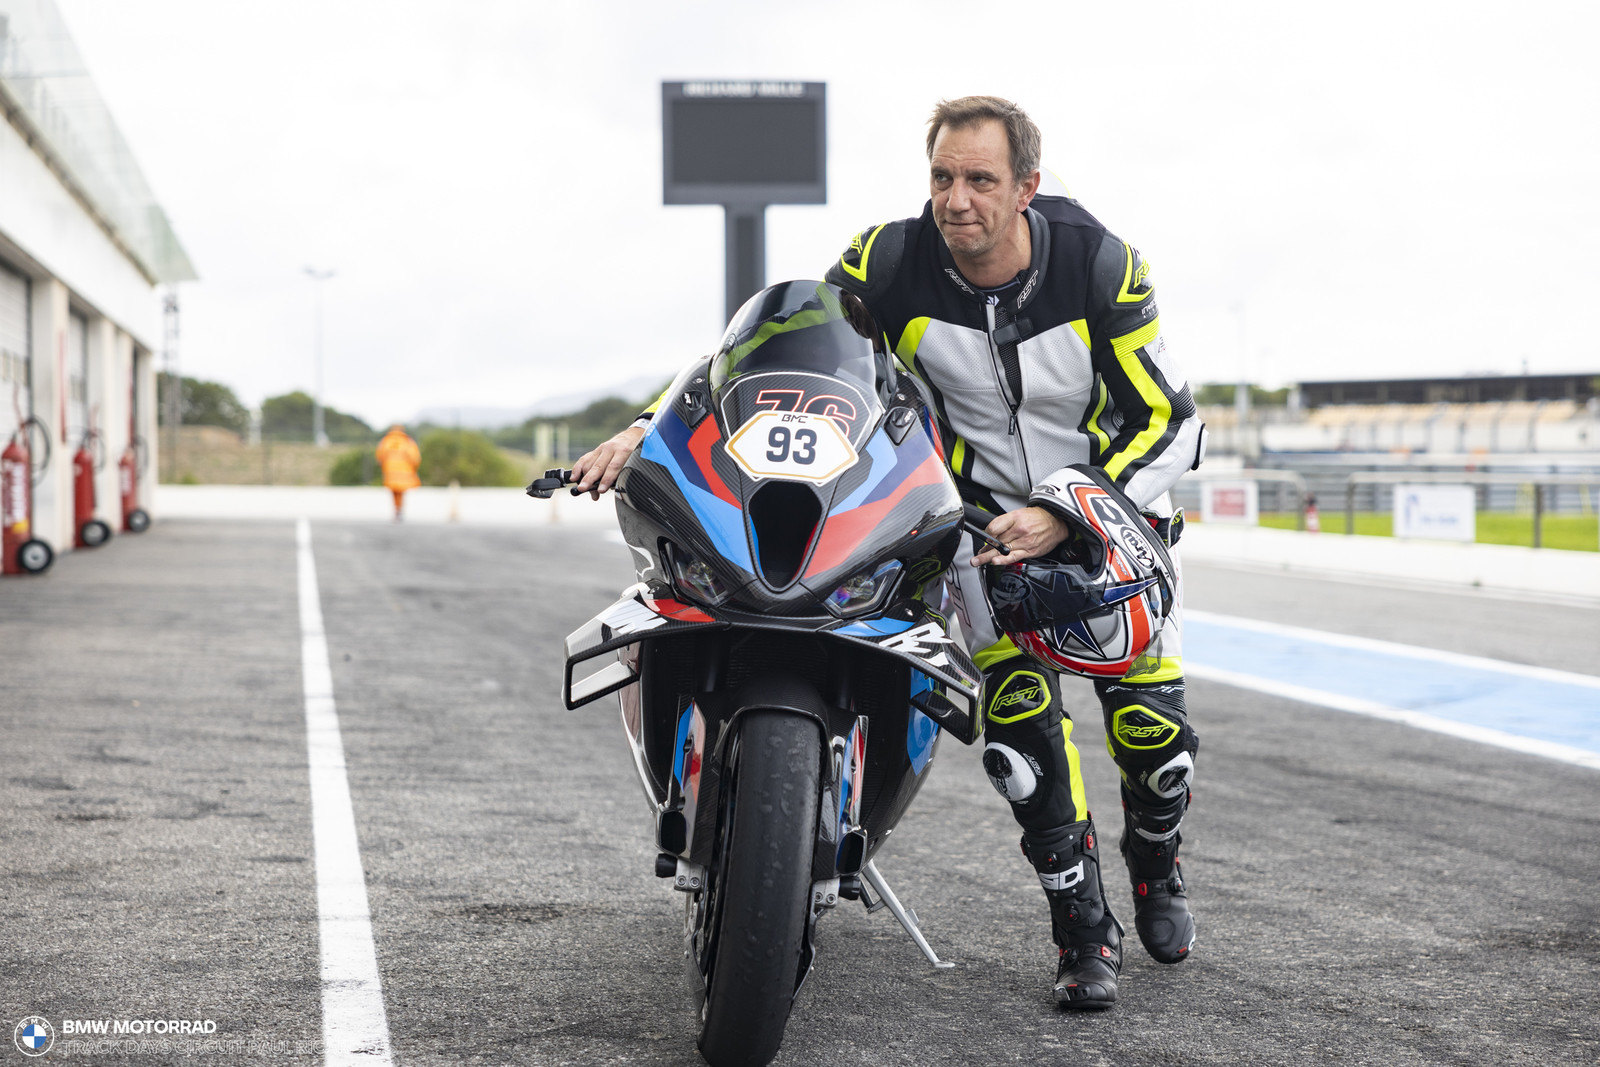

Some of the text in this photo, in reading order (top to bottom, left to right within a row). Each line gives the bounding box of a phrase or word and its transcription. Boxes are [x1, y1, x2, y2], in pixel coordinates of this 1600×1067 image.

[944, 268, 975, 294] RST
[1017, 270, 1039, 309] RST
[781, 413, 808, 424] BMC
[766, 426, 817, 465] 93
[1123, 531, 1154, 565] Arai
[993, 685, 1042, 713] RST
[1118, 723, 1170, 738] RST
